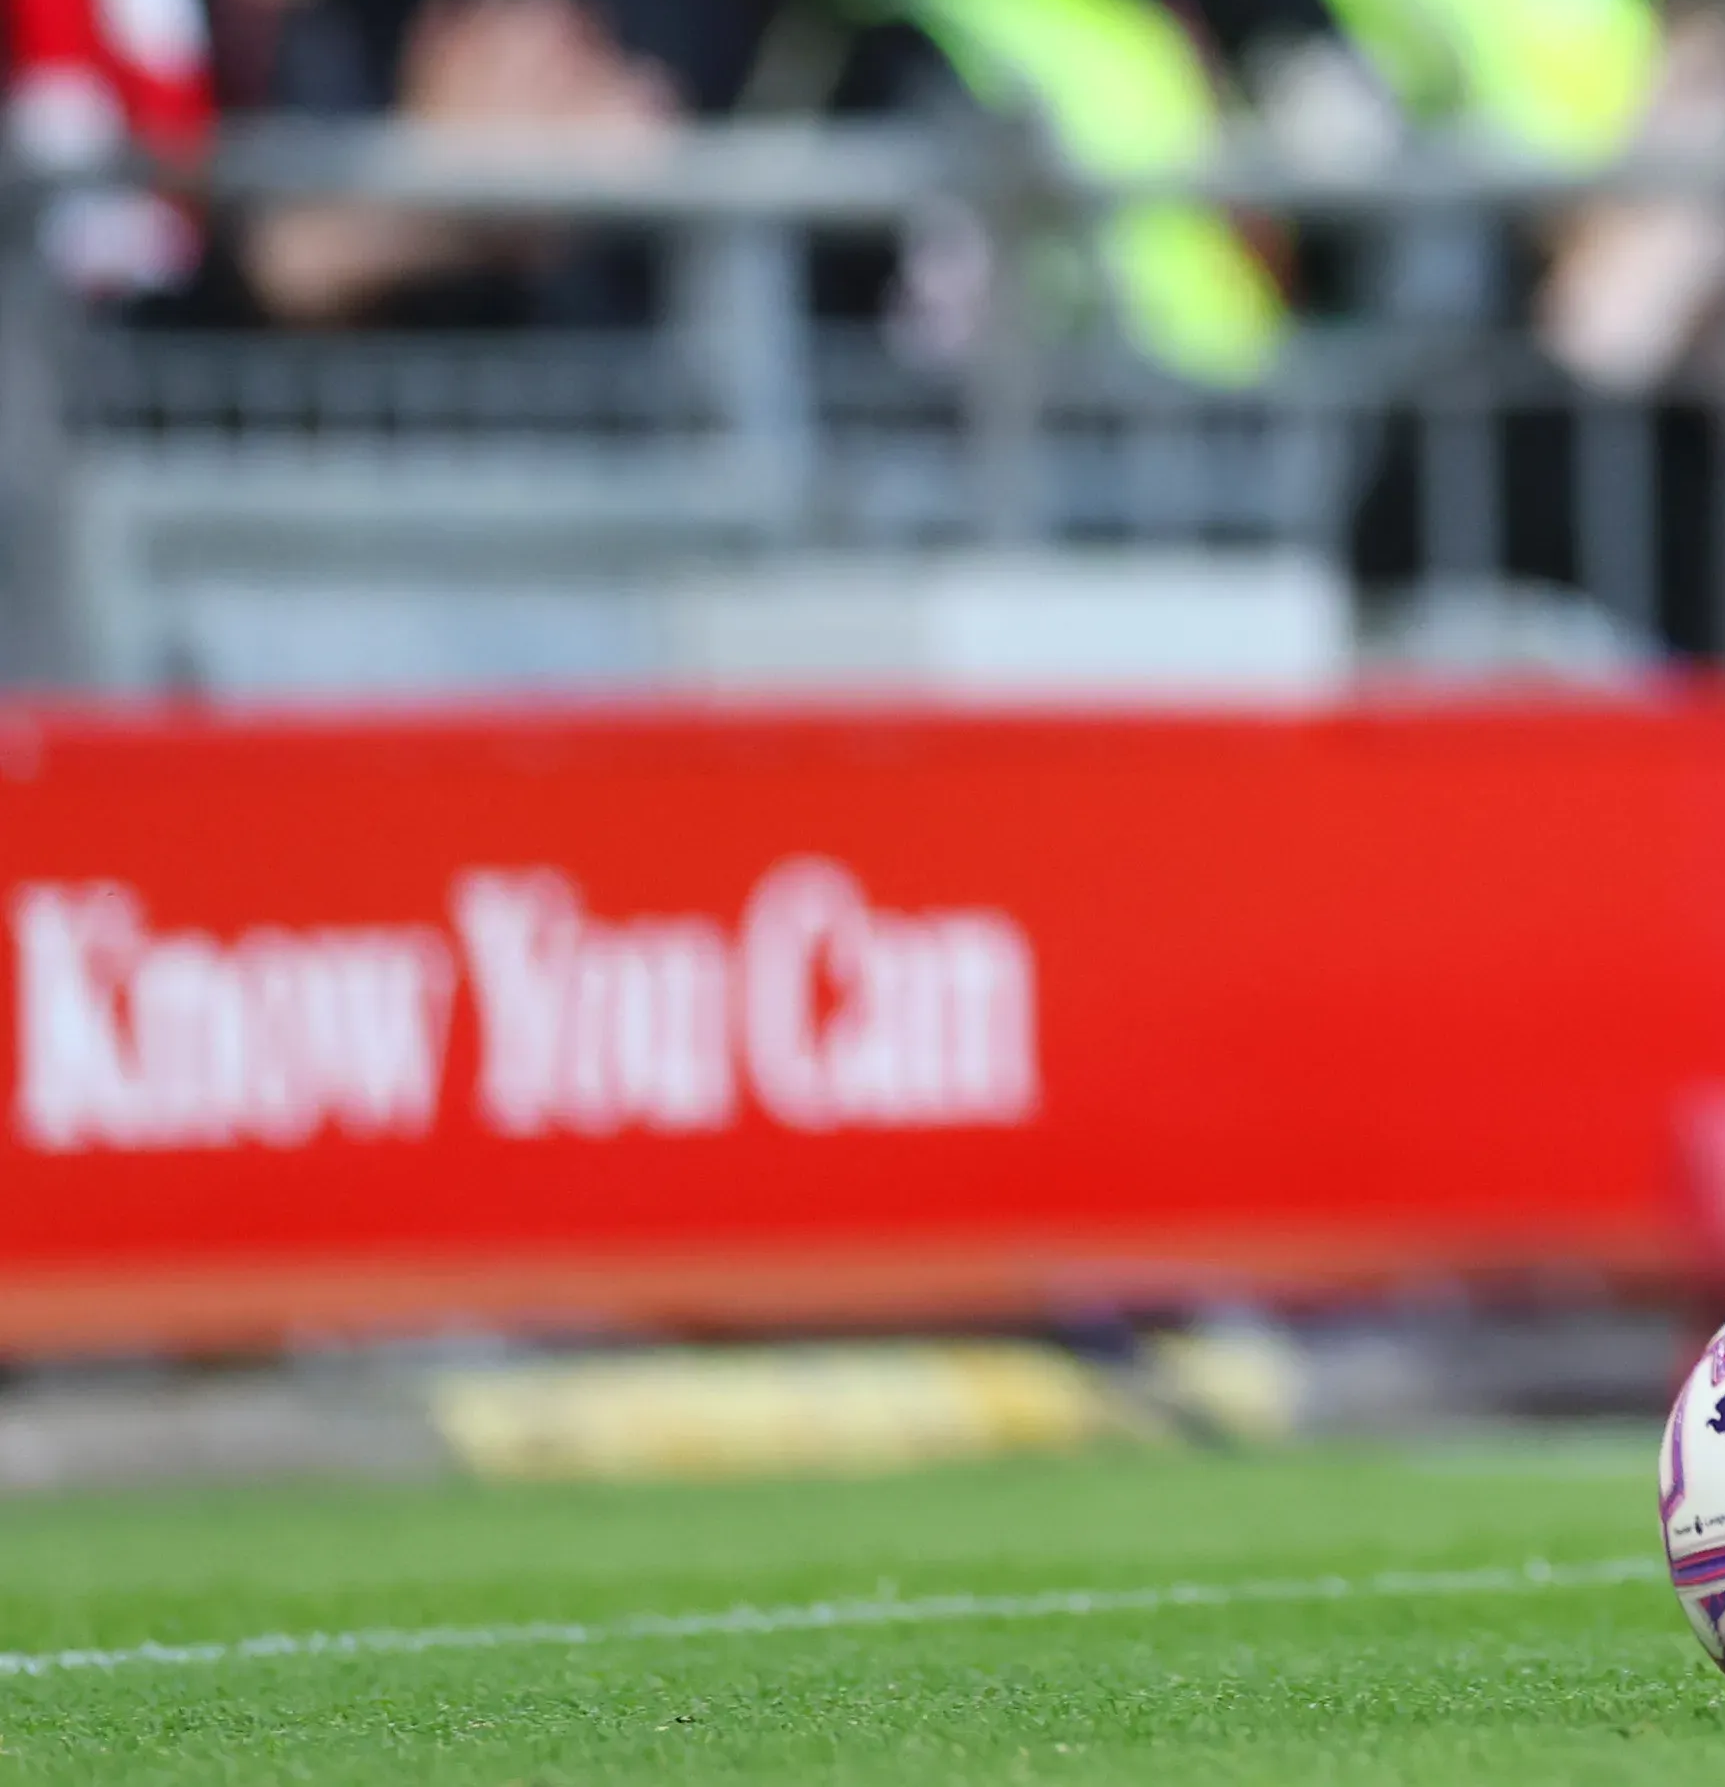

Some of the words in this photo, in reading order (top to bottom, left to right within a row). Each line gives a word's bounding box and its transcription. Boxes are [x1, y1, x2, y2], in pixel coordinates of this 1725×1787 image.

[15, 884, 454, 1146] Know
[453, 869, 736, 1135] You
[742, 857, 1037, 1130] Can
